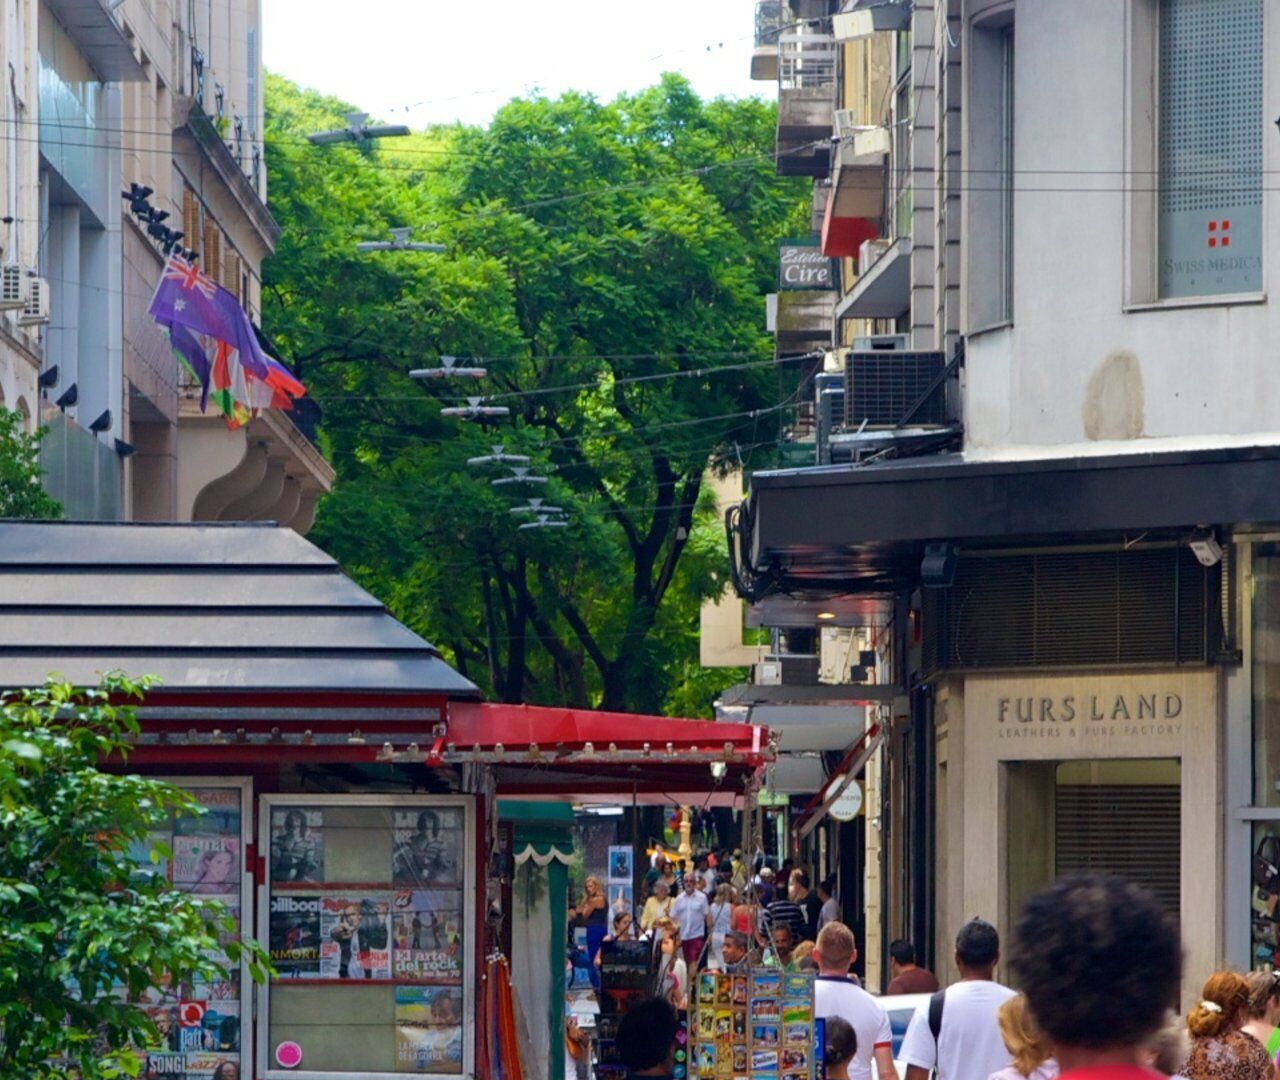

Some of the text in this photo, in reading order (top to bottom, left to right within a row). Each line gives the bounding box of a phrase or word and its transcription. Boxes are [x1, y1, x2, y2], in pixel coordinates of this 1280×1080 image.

[785, 265, 828, 282] Cire
[998, 694, 1183, 722] FURS LAND
[999, 727, 1061, 738] LEATHERS
[1085, 726, 1116, 737] FURS
[1123, 725, 1183, 736] FACTORY
[418, 952, 447, 961] arte
[396, 959, 457, 972] del rock
[180, 1002, 204, 1027] Q
